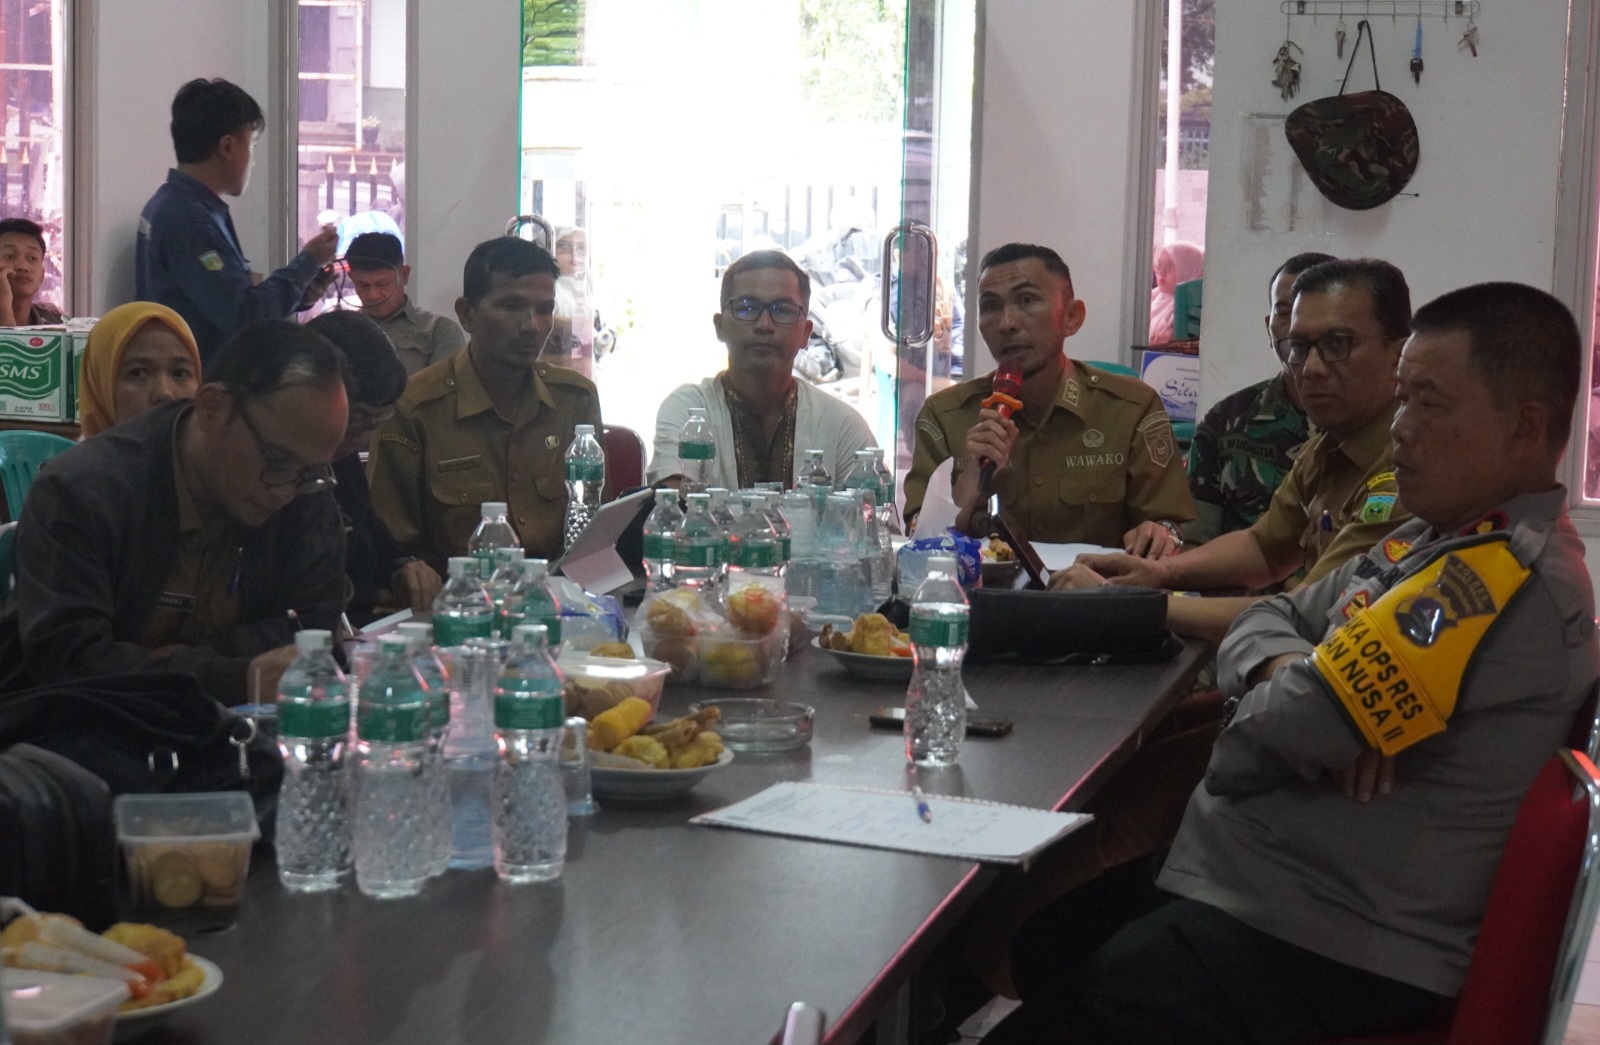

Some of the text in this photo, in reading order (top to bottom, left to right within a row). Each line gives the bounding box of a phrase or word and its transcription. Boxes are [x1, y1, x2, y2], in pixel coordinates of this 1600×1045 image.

[1065, 452, 1124, 468] WAWAKO
[1322, 633, 1350, 661] AN
[1340, 659, 1392, 728] NUSA
